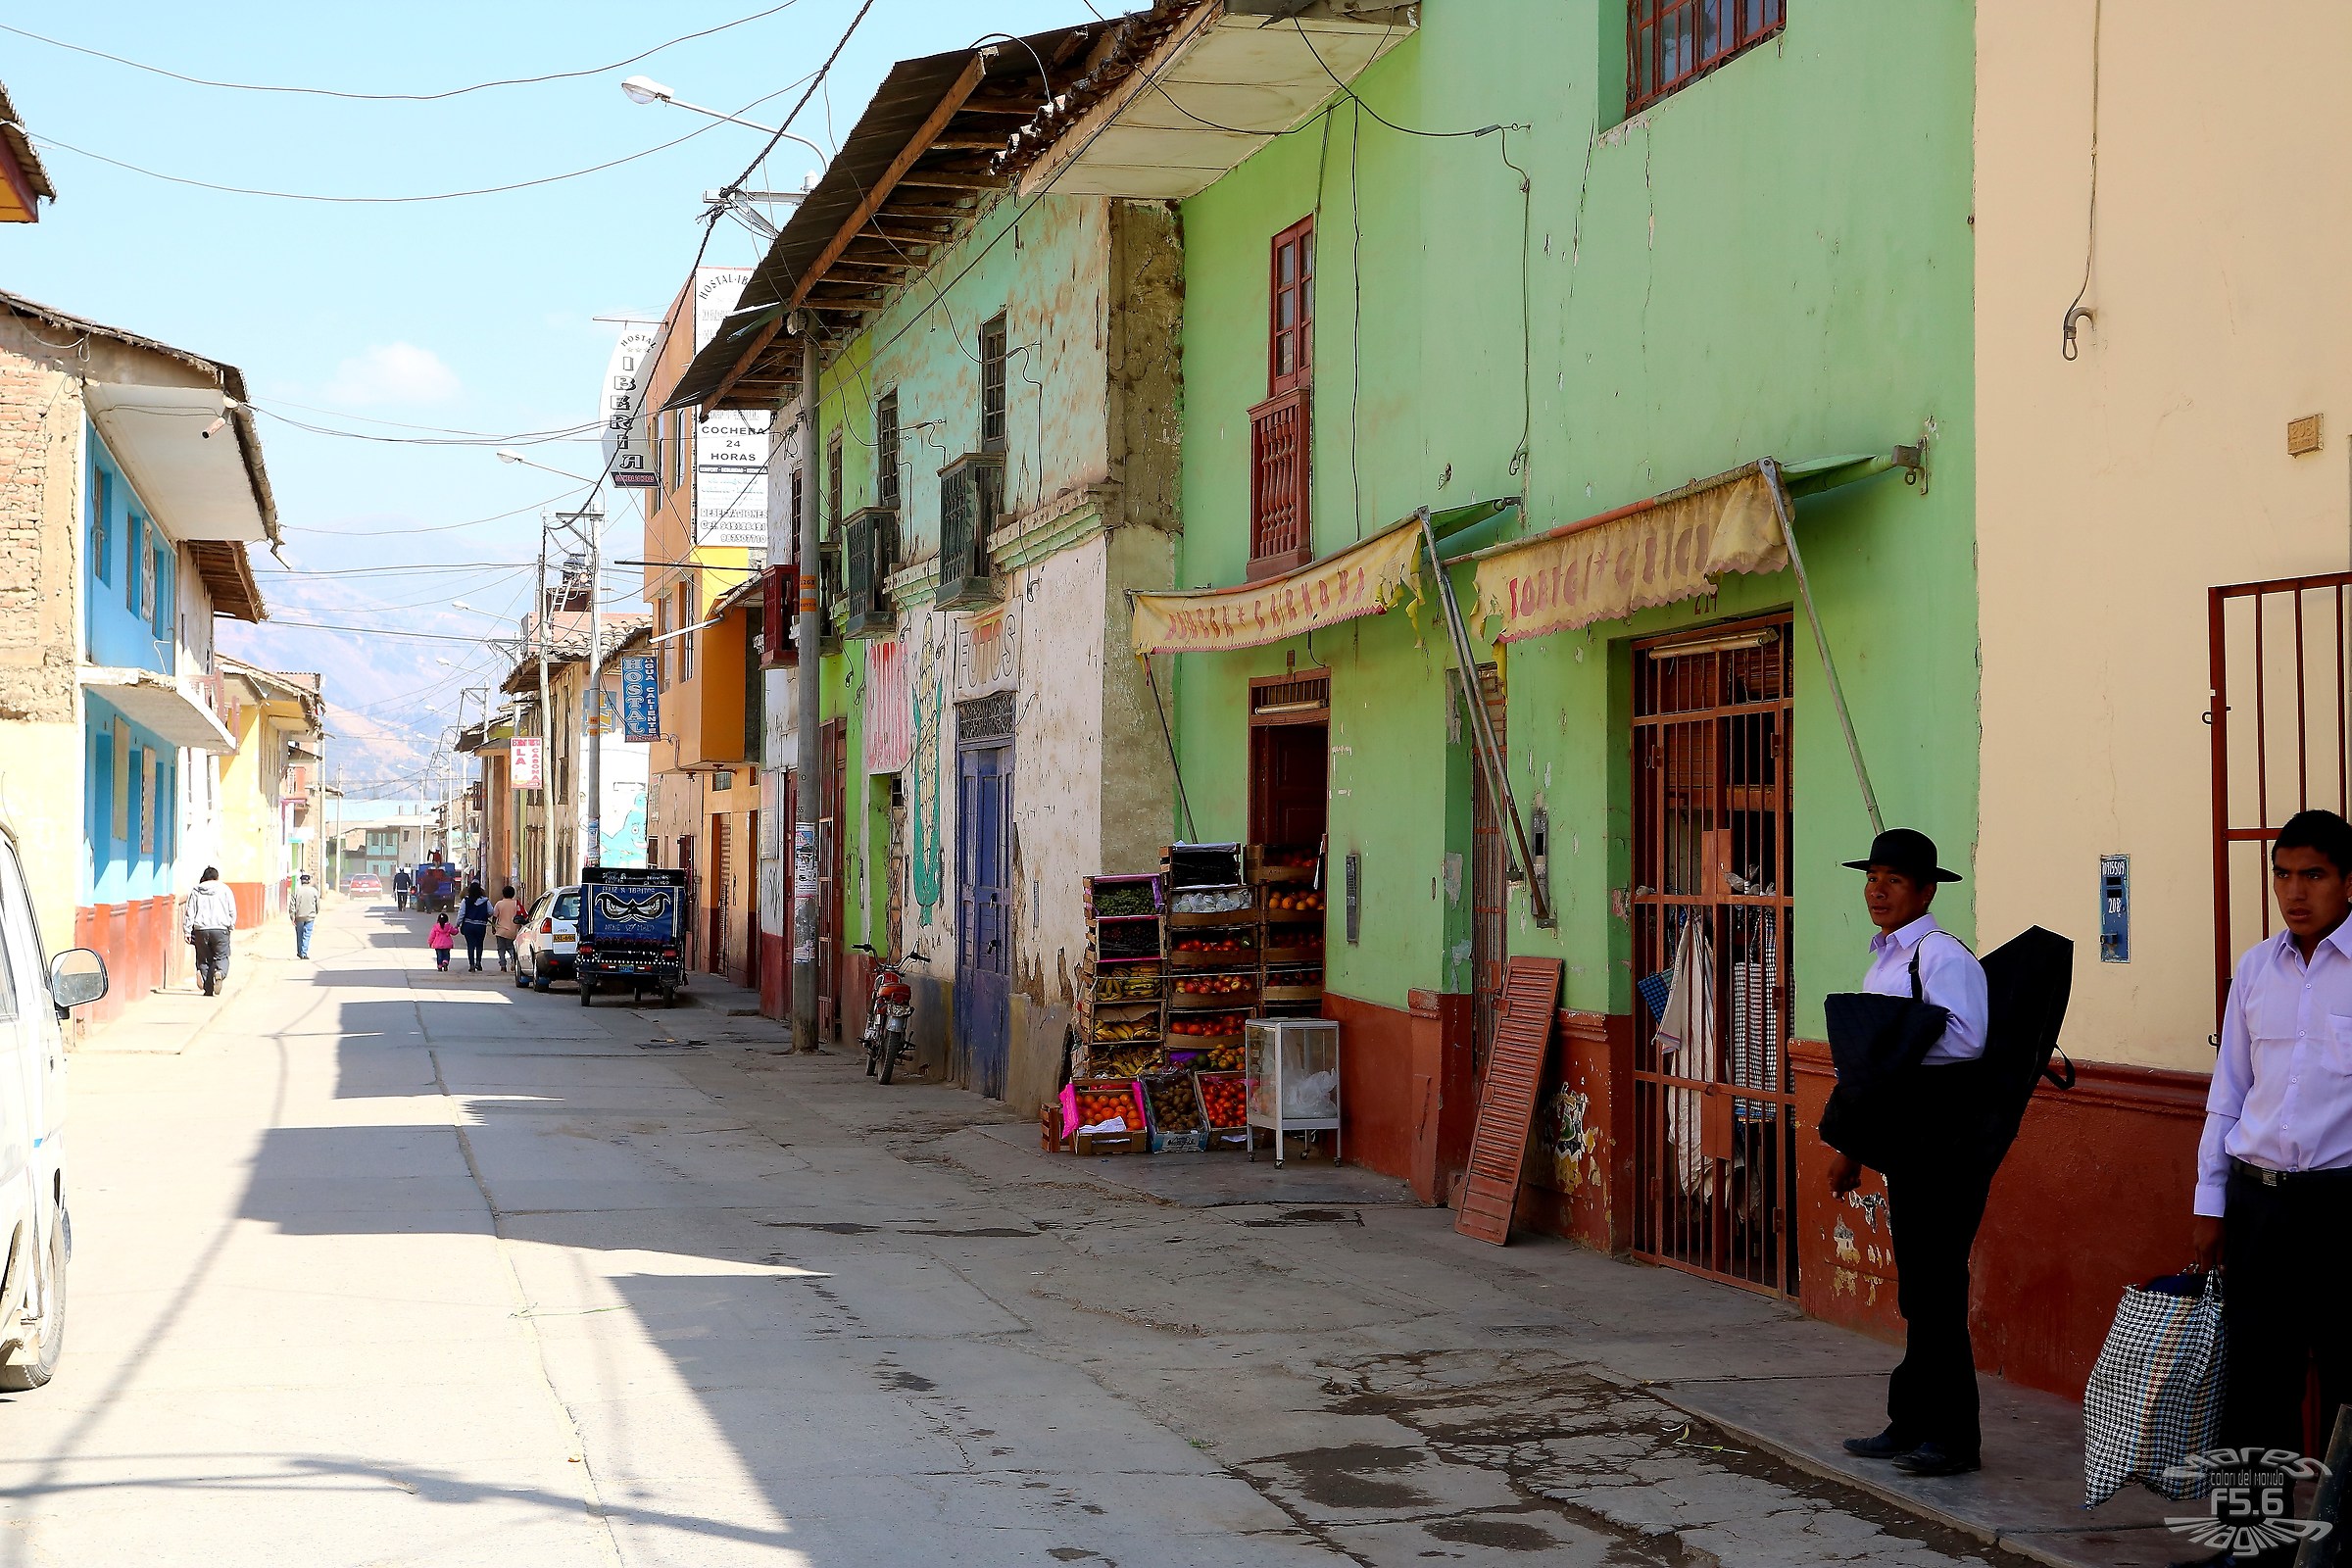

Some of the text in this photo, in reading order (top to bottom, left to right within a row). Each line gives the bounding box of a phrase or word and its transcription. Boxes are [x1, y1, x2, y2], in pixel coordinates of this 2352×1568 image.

[699, 274, 733, 299] HOSTAL
[620, 334, 658, 349] HOSTAL
[957, 612, 1017, 689] FOTOS
[623, 658, 646, 735] HOSTAL
[644, 658, 657, 733] AGUA CALIENTE
[515, 748, 540, 780] LA CASONA
[2108, 898, 2121, 913] 208
